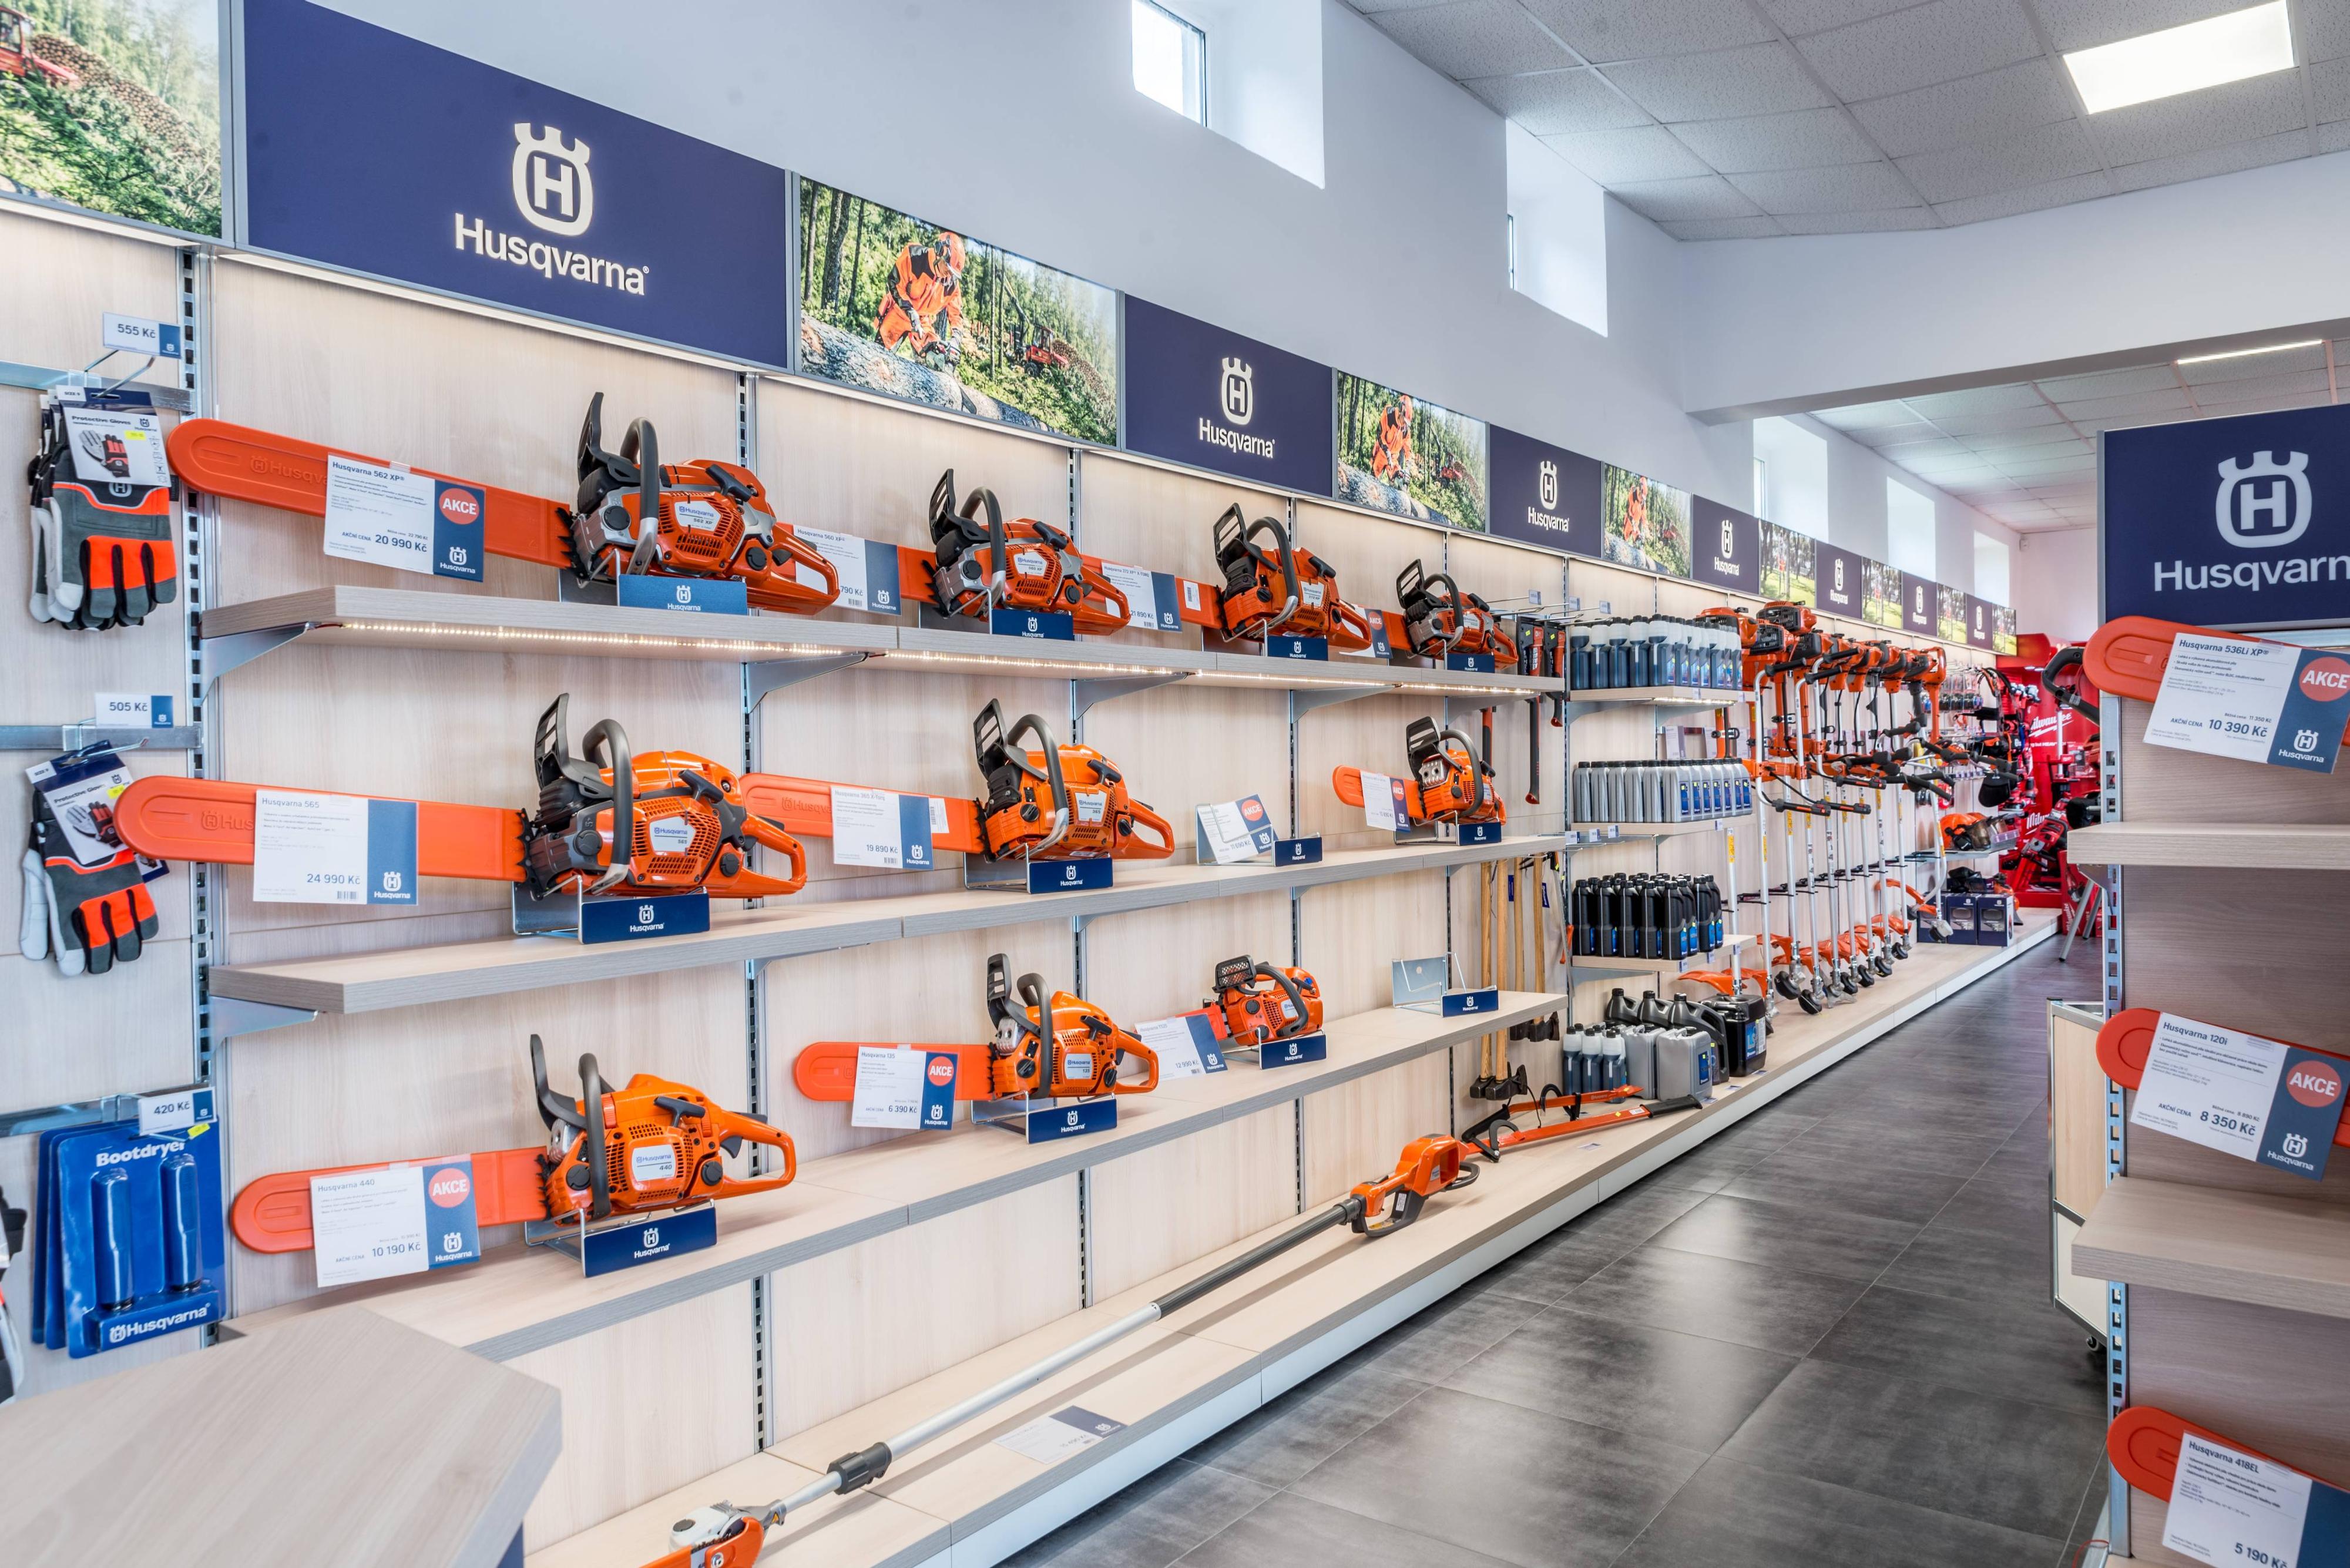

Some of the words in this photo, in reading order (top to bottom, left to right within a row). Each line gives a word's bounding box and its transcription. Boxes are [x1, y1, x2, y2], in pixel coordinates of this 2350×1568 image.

[118, 324, 139, 336] 555
[142, 328, 156, 338] Kč
[72, 415, 109, 424] Protective
[1199, 418, 1274, 458] Husqvarna
[332, 461, 372, 476] Husqvarna
[374, 471, 388, 479] 562
[442, 498, 477, 515] AKCE
[686, 508, 714, 517] Husqvarna
[1528, 506, 1569, 533] Husqvarna
[342, 531, 358, 540] AKČNÍ
[797, 529, 824, 538] Husqvarna
[375, 535, 389, 545] 20
[391, 538, 412, 549] 990
[415, 542, 427, 552] Kč
[440, 562, 476, 574] Husqvarna
[1714, 556, 1739, 576] Husqvarna
[840, 586, 853, 594] 790
[667, 603, 701, 612] Husqvarna
[872, 602, 897, 610] Husqvarna
[1369, 616, 1382, 625] AKCE
[1022, 630, 1043, 639] Husqvarna
[2178, 639, 2223, 652] Husqvarna
[2225, 645, 2250, 656] 536Li
[2302, 670, 2350, 689] AKCE
[109, 701, 132, 711] 505
[134, 701, 147, 711] Kč
[2170, 717, 2188, 726] AKČNÍ
[2188, 720, 2203, 728] CENA
[2209, 718, 2223, 730] 10
[2224, 721, 2250, 734] 390
[2252, 726, 2268, 738] Kč
[2278, 748, 2325, 764] Husqvarna
[53, 790, 86, 804] Protective
[835, 790, 860, 799] Husqvarna
[1392, 786, 1404, 795] AKCE
[261, 798, 302, 808] Husqvarna
[304, 800, 320, 808] 565
[1243, 804, 1262, 817] AKCE
[661, 827, 688, 836] Husqvarna
[307, 874, 321, 883] 24
[324, 874, 345, 884] 990
[348, 875, 361, 885] Kč
[374, 891, 411, 899] Husqvarna
[630, 922, 664, 932] Husqvarna
[2163, 1022, 2207, 1040] Husqvarna
[2210, 1034, 2228, 1046] 120i
[929, 1066, 952, 1077] AKCE
[2289, 1072, 2338, 1097] AKCE
[154, 1103, 174, 1115] 420
[177, 1100, 190, 1112] Kč
[895, 1105, 908, 1113] 390
[2158, 1103, 2176, 1113] AKČNÍ
[2176, 1108, 2192, 1117] CENA
[1061, 1123, 1085, 1133] Husqvarna
[2200, 1111, 2209, 1122] 8
[2211, 1114, 2237, 1130] 350
[2240, 1122, 2256, 1136] Kč
[96, 1139, 186, 1168] Bootdryer
[642, 1153, 672, 1163] Husqvarna
[2268, 1150, 2314, 1171] Husqvarna
[318, 1180, 357, 1193] Husqvarna
[359, 1178, 375, 1187] 440
[432, 1179, 468, 1196] AKCE
[372, 1247, 384, 1258] 10
[387, 1244, 405, 1255] 190
[408, 1242, 421, 1253] Kč
[435, 1251, 473, 1262] Husqvarna
[634, 1244, 669, 1260] Husqvarna
[2188, 1440, 2234, 1464] Husqvarna
[2235, 1458, 2260, 1474] 418EL
[2234, 1542, 2244, 1554] 5
[2246, 1547, 2269, 1565] 190
[2271, 1556, 2288, 1568] Kč
